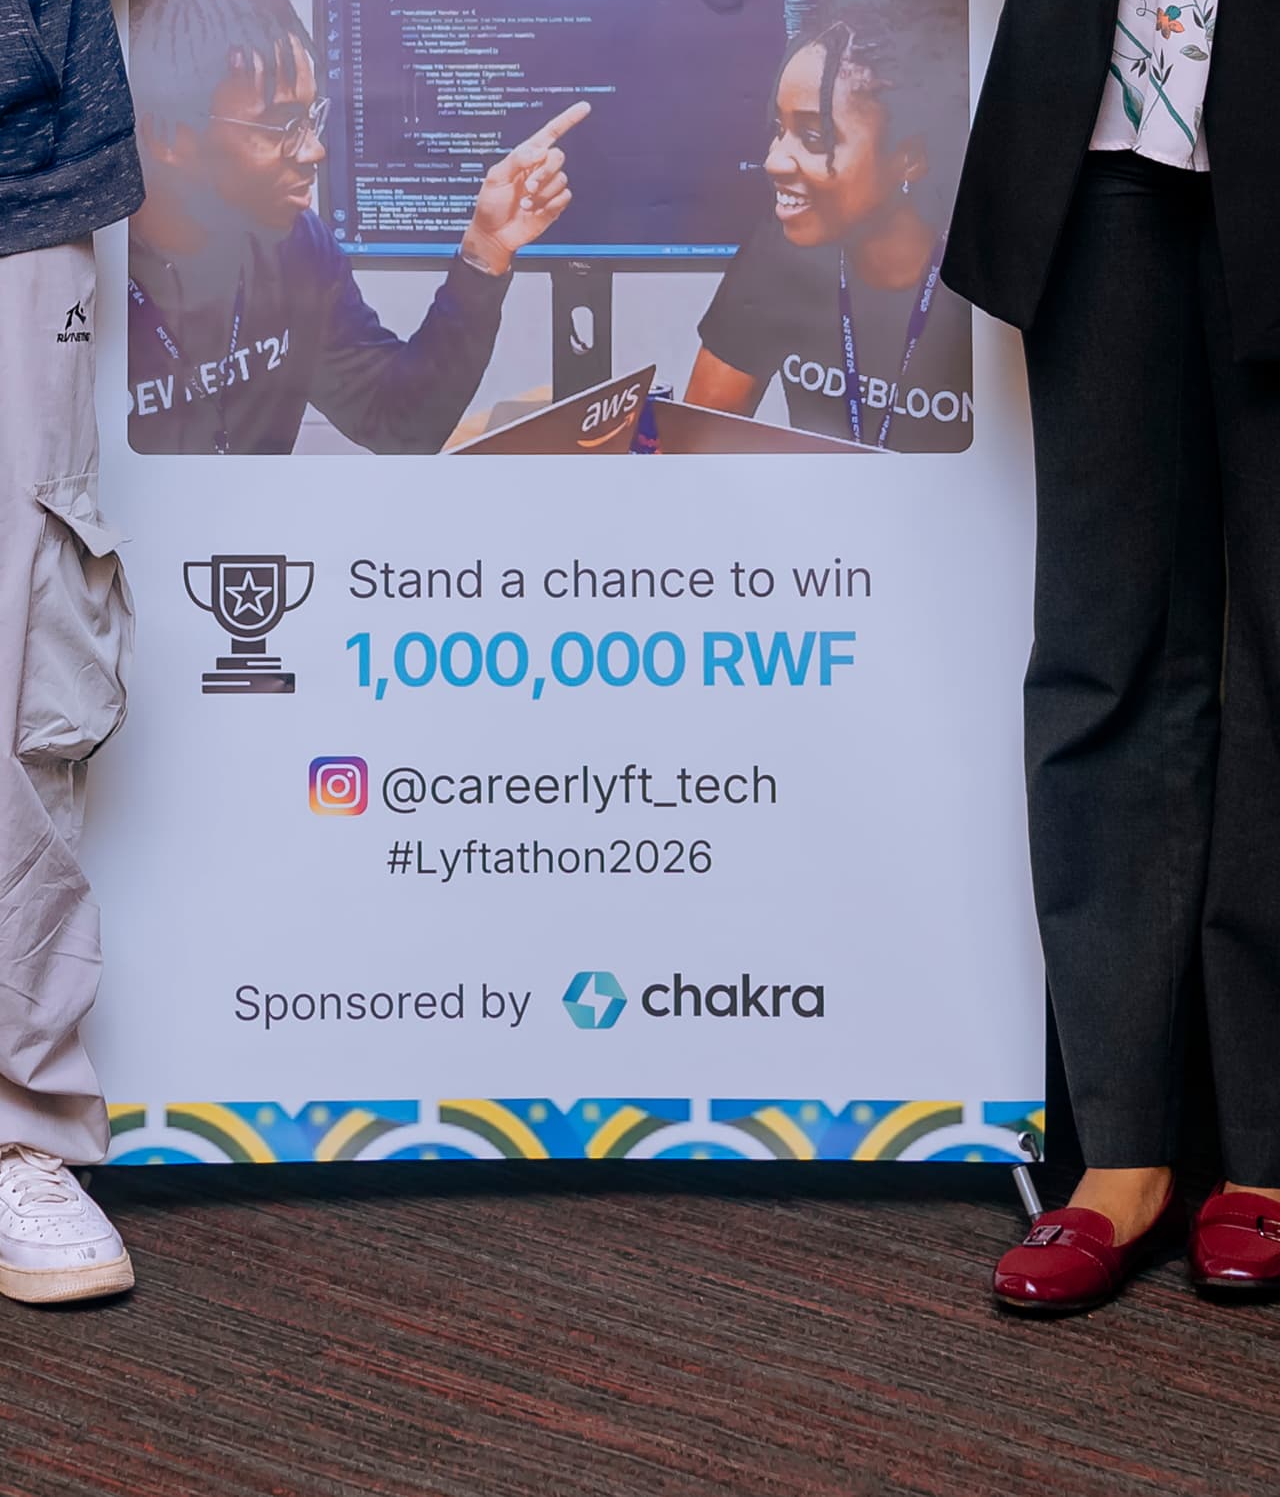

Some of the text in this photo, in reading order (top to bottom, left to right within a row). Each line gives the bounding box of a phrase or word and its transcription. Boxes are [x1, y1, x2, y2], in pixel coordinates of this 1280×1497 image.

[185, 348, 250, 401] EST
[582, 383, 640, 432] aws
[349, 557, 871, 599] Stand a chance to win
[346, 630, 856, 701] 1,000,000 RWF
[382, 763, 777, 814] @careerlyft_tech
[386, 839, 712, 883] #Lyftathon2026
[234, 972, 825, 1031] Sponsored by chakra
